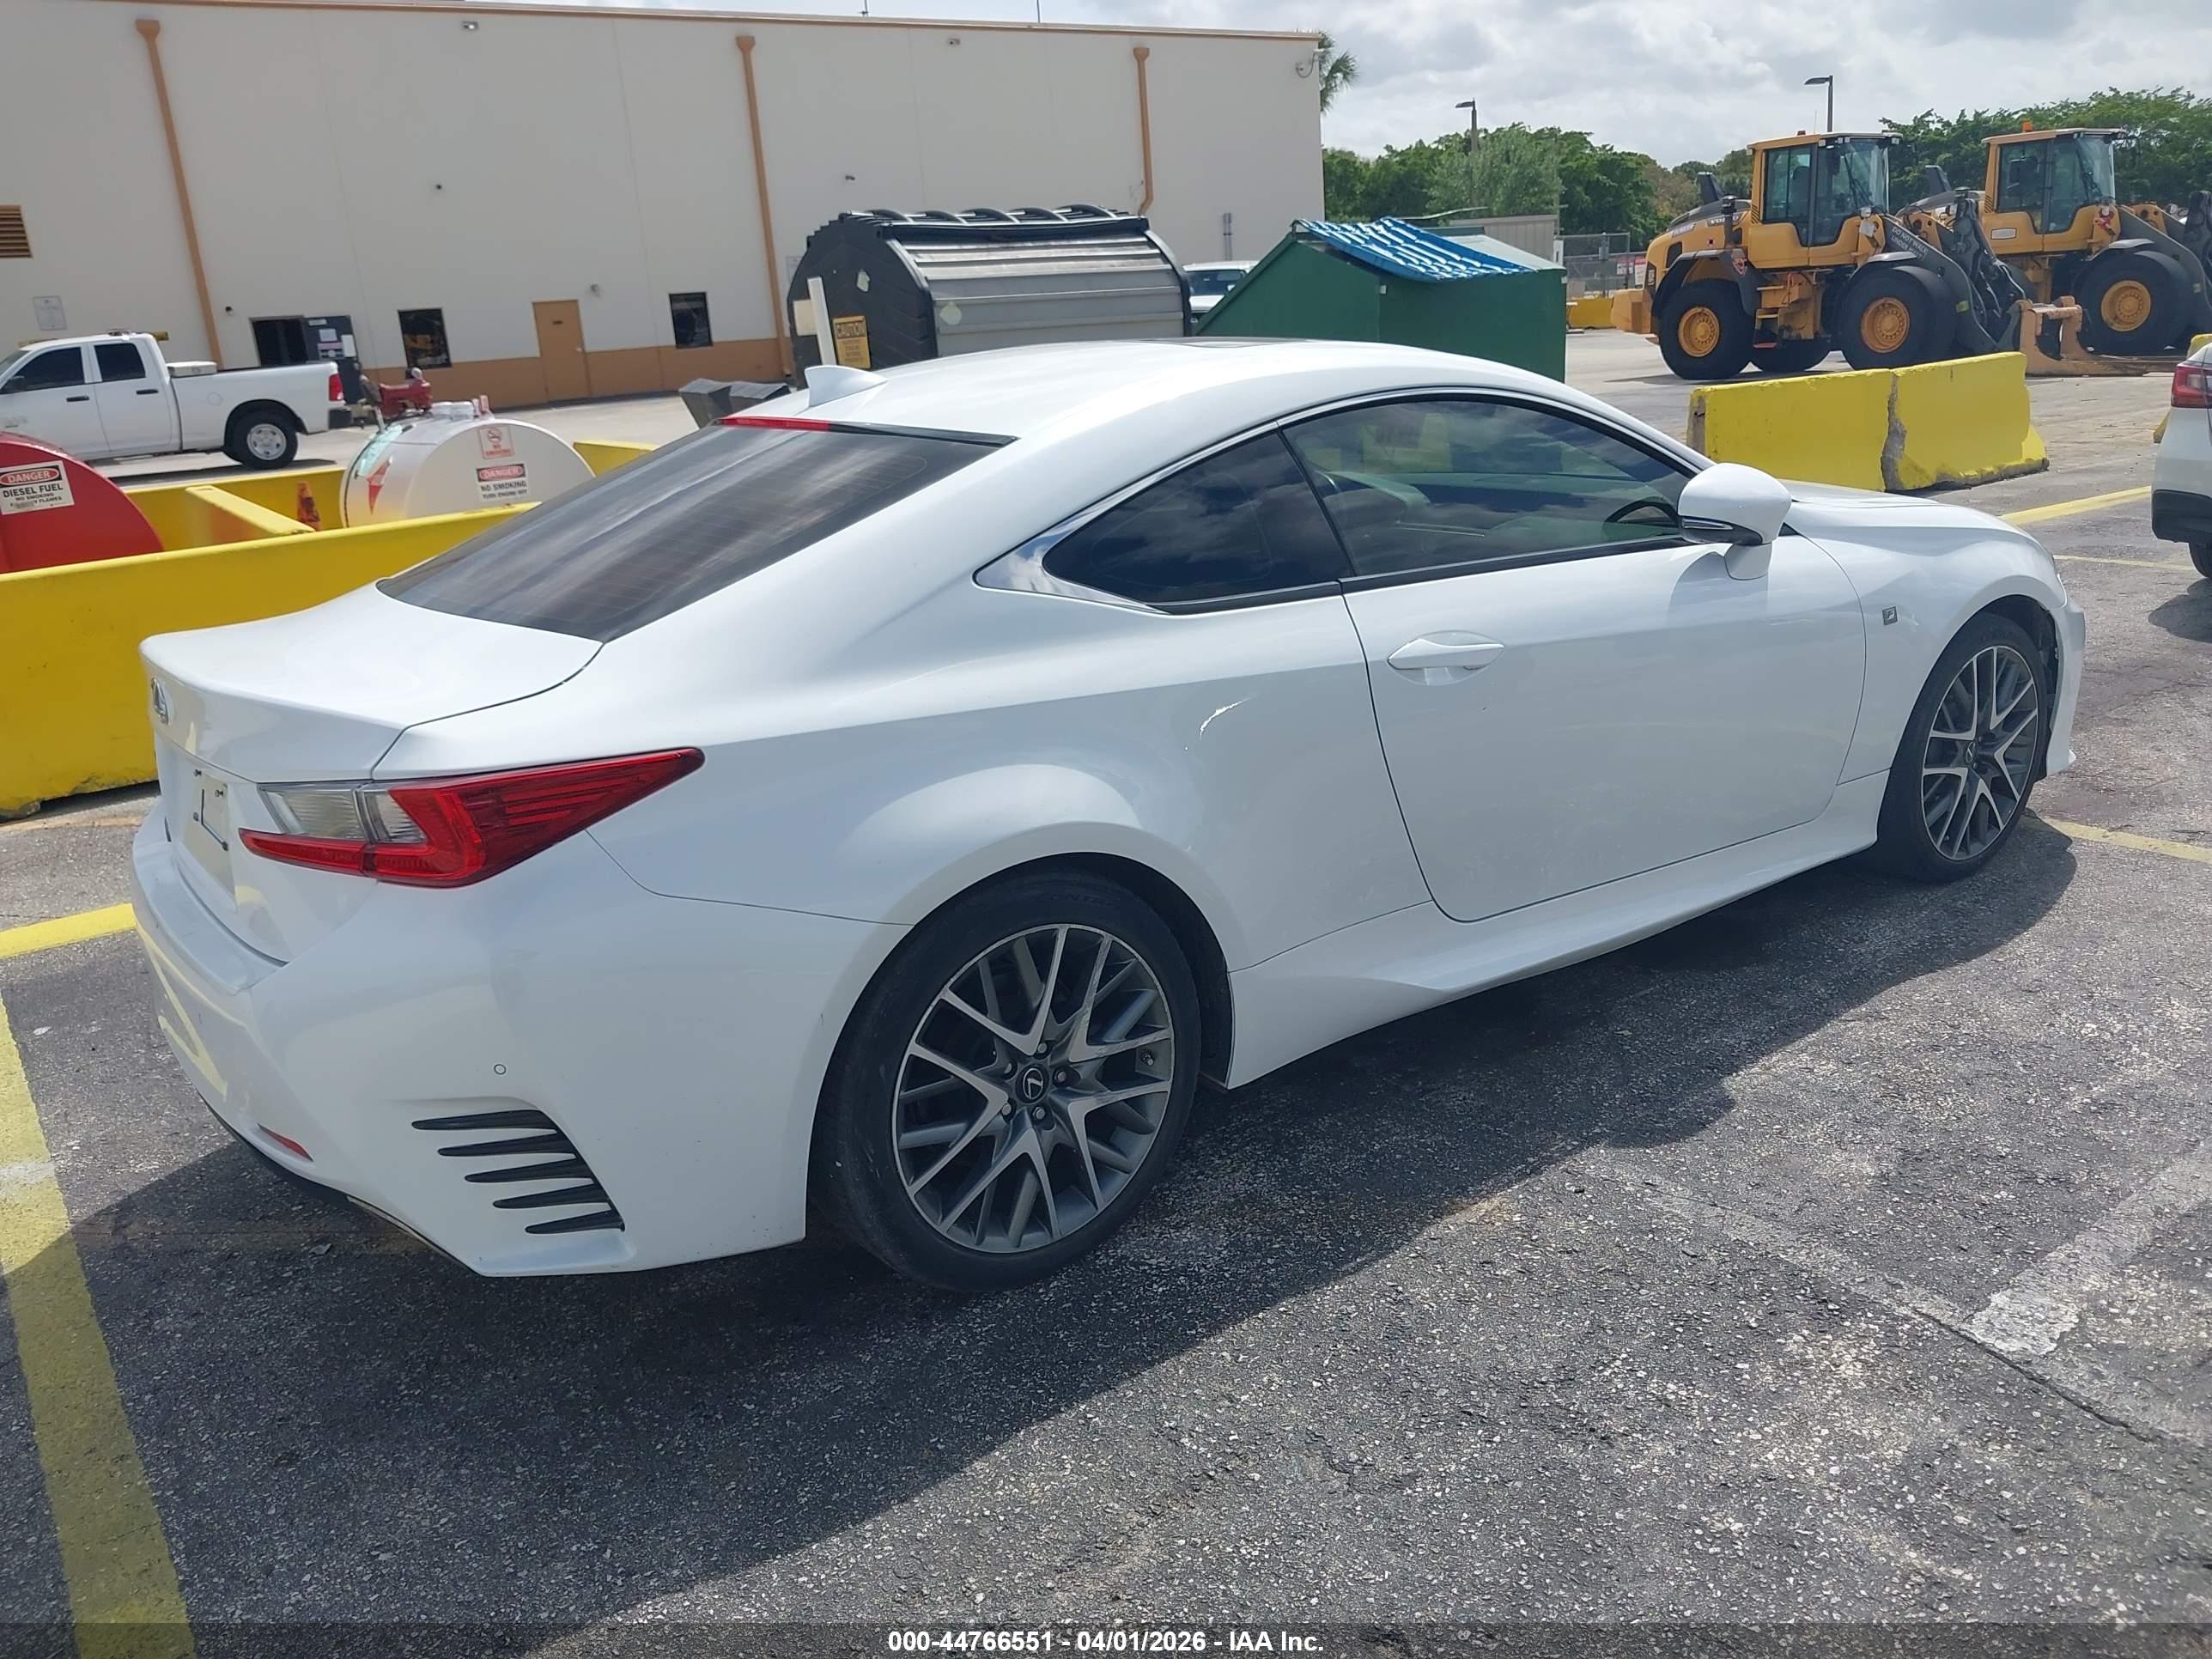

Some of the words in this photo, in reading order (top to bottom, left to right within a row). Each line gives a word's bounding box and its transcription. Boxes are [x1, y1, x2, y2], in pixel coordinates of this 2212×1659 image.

[7, 471, 51, 483] DANGER
[3, 487, 37, 498] DIESEL
[39, 483, 64, 493] FUEL
[493, 480, 526, 489] SMOKING
